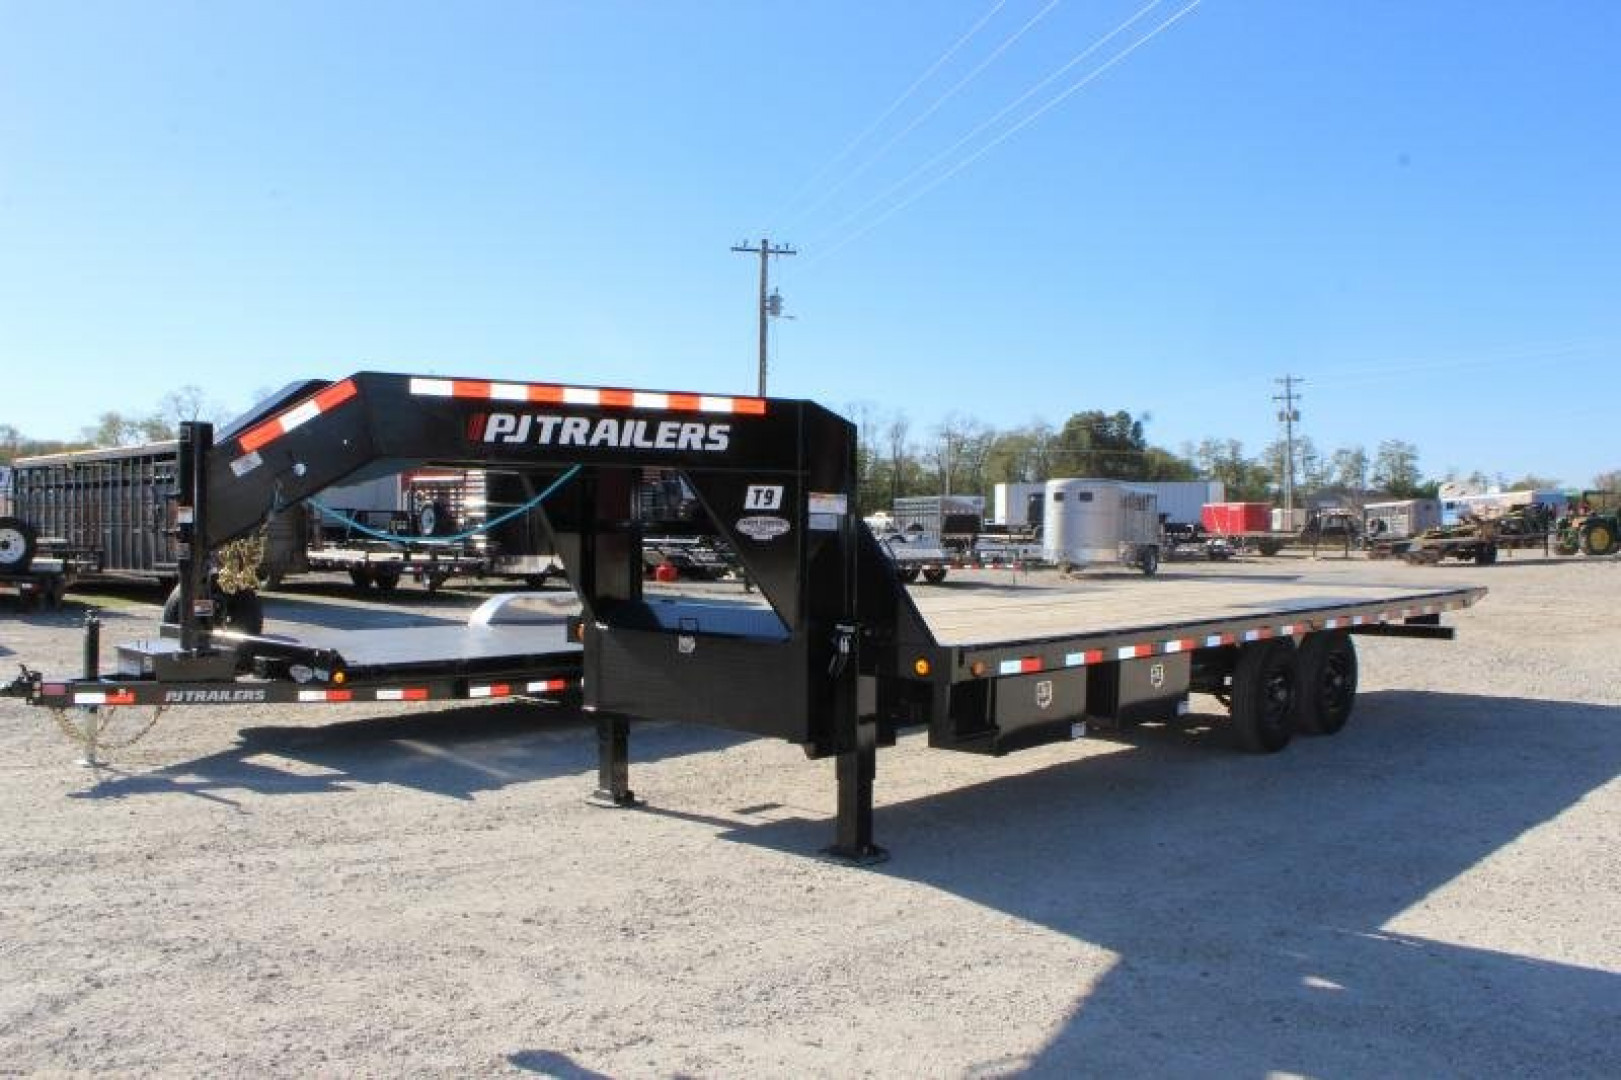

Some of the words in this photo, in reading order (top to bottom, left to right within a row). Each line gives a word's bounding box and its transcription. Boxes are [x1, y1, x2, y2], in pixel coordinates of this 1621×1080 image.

[484, 412, 531, 443] PJ
[537, 415, 730, 450] TRAILERS
[753, 489, 775, 506] T9
